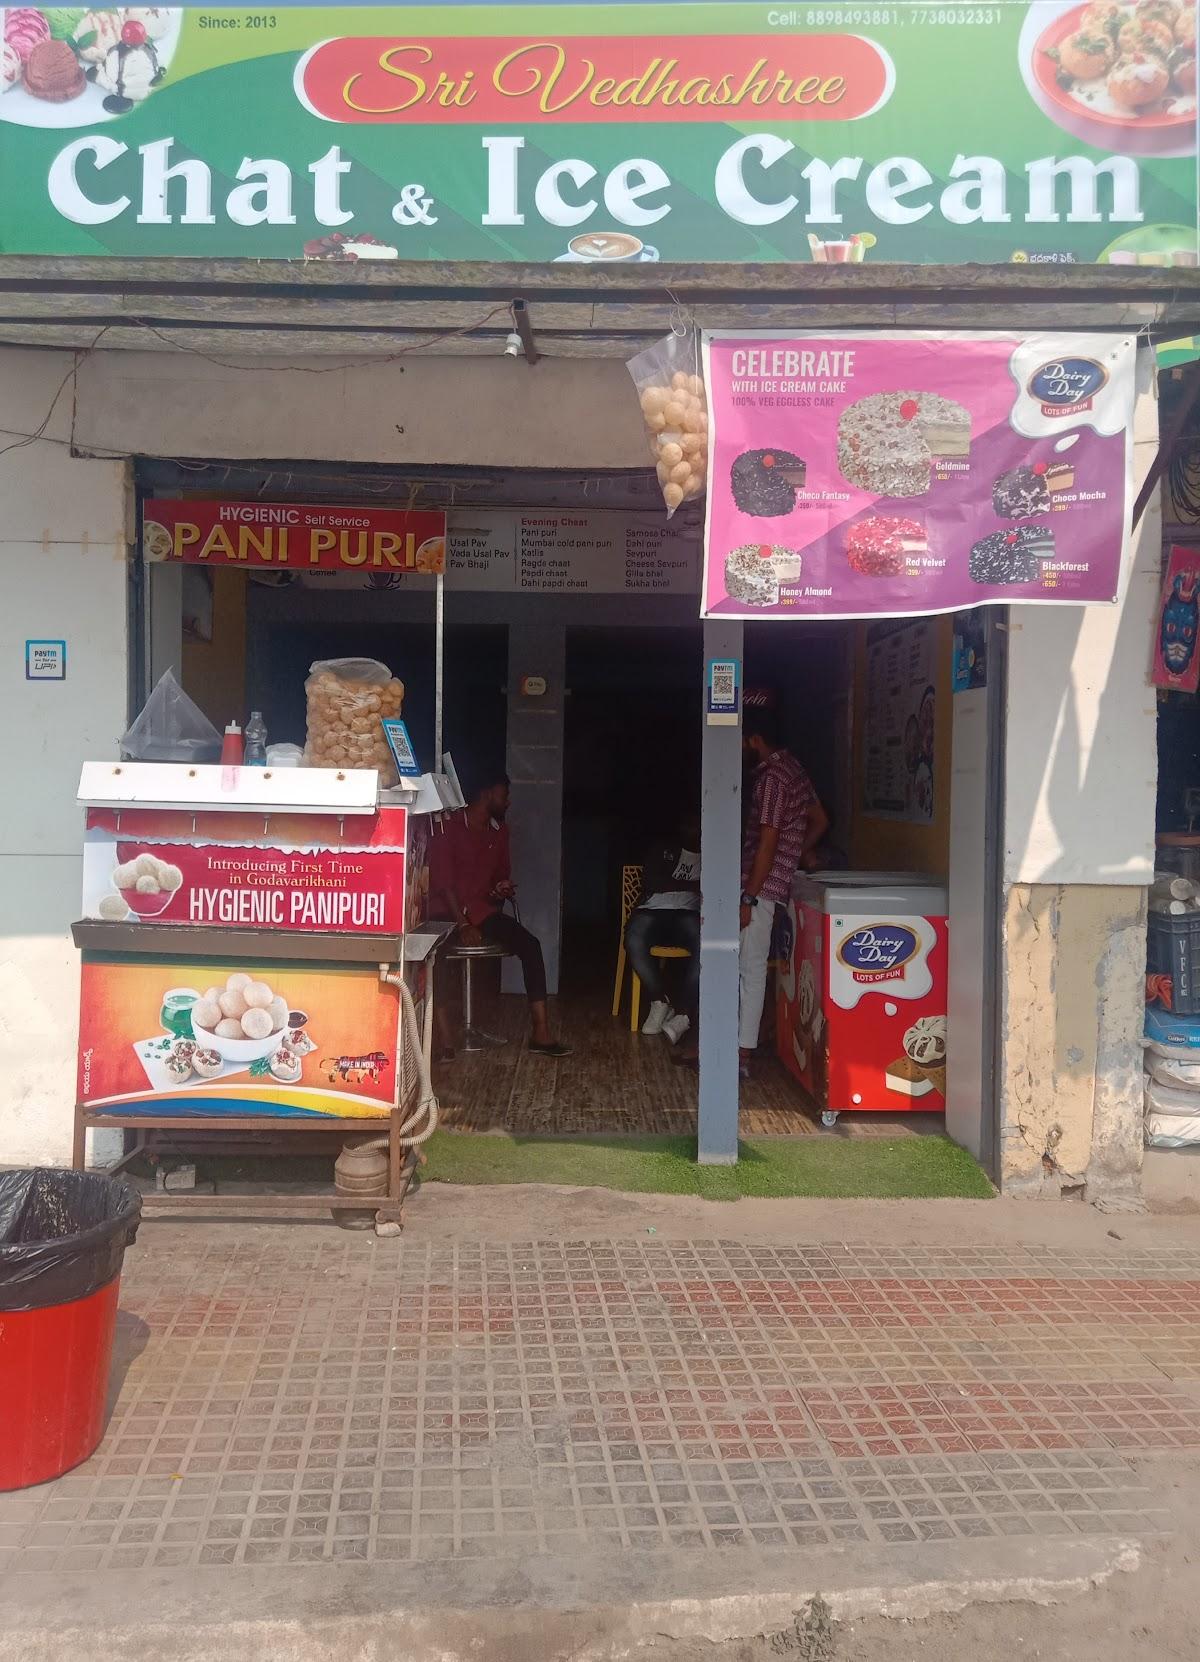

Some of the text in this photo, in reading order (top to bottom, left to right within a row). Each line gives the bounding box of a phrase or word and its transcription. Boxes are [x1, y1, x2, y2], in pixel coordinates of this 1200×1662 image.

[199, 16, 277, 29] Since: 2013
[767, 10, 801, 27] Cell:
[910, 10, 1002, 26] 7738032331
[342, 43, 846, 113] Sri Vedhashree
[48, 133, 1144, 227] Chat & Ice Cream
[732, 350, 856, 378] CELEBRATE
[1043, 363, 1092, 387] Dairy
[732, 381, 846, 393] WITH ICE CREAM CAKE
[1048, 380, 1084, 402] Day
[732, 397, 835, 407] 100% VEG EGGLESS CAKE
[1044, 402, 1088, 415] LOTS OF FUN
[935, 462, 970, 471] Goldmine
[797, 491, 850, 502] Choco Fantasy
[1052, 491, 1106, 503] Choco Mocha
[219, 506, 371, 527] HYGIENIC Self Service
[521, 518, 558, 527] Evening
[541, 529, 557, 538] puri
[173, 522, 416, 568] PANI PURI
[450, 539, 487, 547] Usal Pav
[521, 539, 613, 549] Mumbai cold pani puri
[473, 550, 492, 558] Usal
[494, 550, 510, 558] Pav
[450, 560, 489, 570] Pav Bhaji
[626, 560, 655, 568] Cheese
[905, 557, 946, 567] Red Velvet
[1042, 561, 1089, 571] Blackforest
[521, 569, 544, 578] Papdi
[521, 579, 540, 587] Dahi
[542, 580, 565, 589] papdi
[780, 586, 833, 597] Honey Almond
[207, 857, 364, 875] Introducing First Time
[229, 872, 347, 887] in Godavarikhani
[189, 887, 386, 926] HYGIENIC PANIPURI
[853, 931, 903, 953] Dairy
[858, 946, 898, 969] Day
[856, 969, 901, 982] LOTS OF FUN
